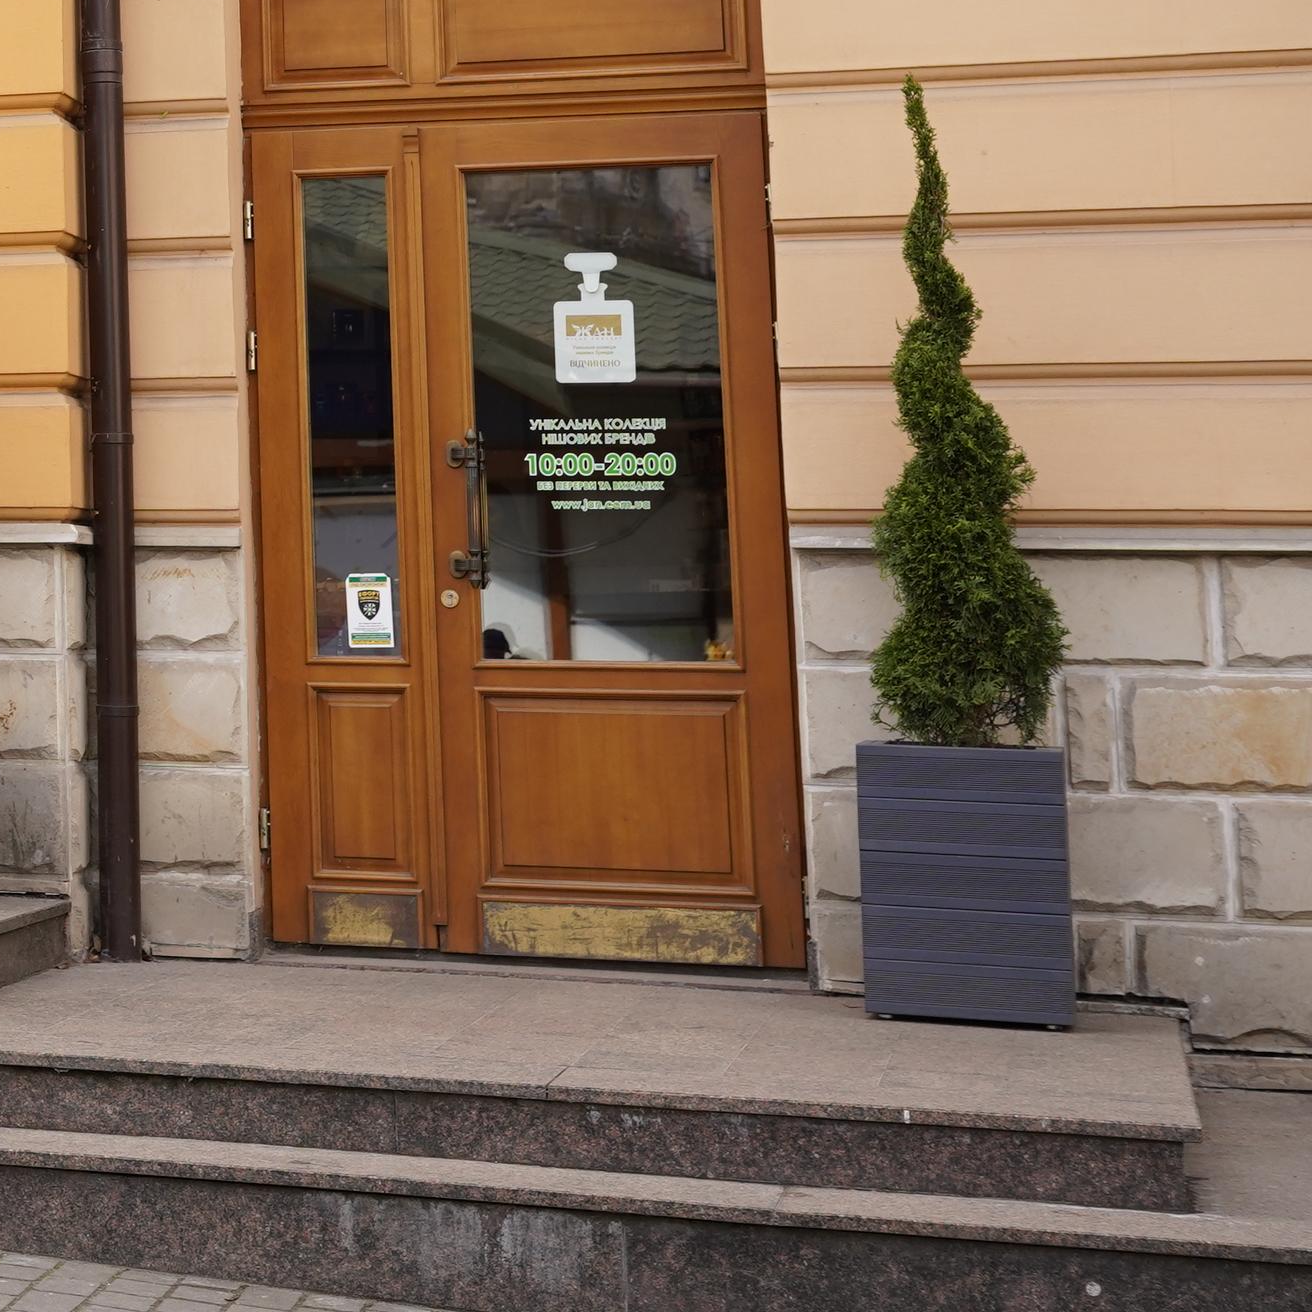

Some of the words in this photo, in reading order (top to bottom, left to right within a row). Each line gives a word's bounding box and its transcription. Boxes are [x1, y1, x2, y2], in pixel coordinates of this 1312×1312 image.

[569, 359, 621, 368] ВІДЧИНЕНО
[529, 418, 602, 430] УНІКАЛЬНА
[604, 418, 667, 431] КОЛЕКЦІЯ
[604, 432, 656, 446] БРЕНДІВ
[524, 452, 677, 476] 10:00-20:00
[537, 481, 554, 491] БЕЗ
[555, 481, 597, 491] ПЕРЕРВИ
[598, 481, 611, 491] ТА
[551, 498, 651, 512] www.jan.com.ua
